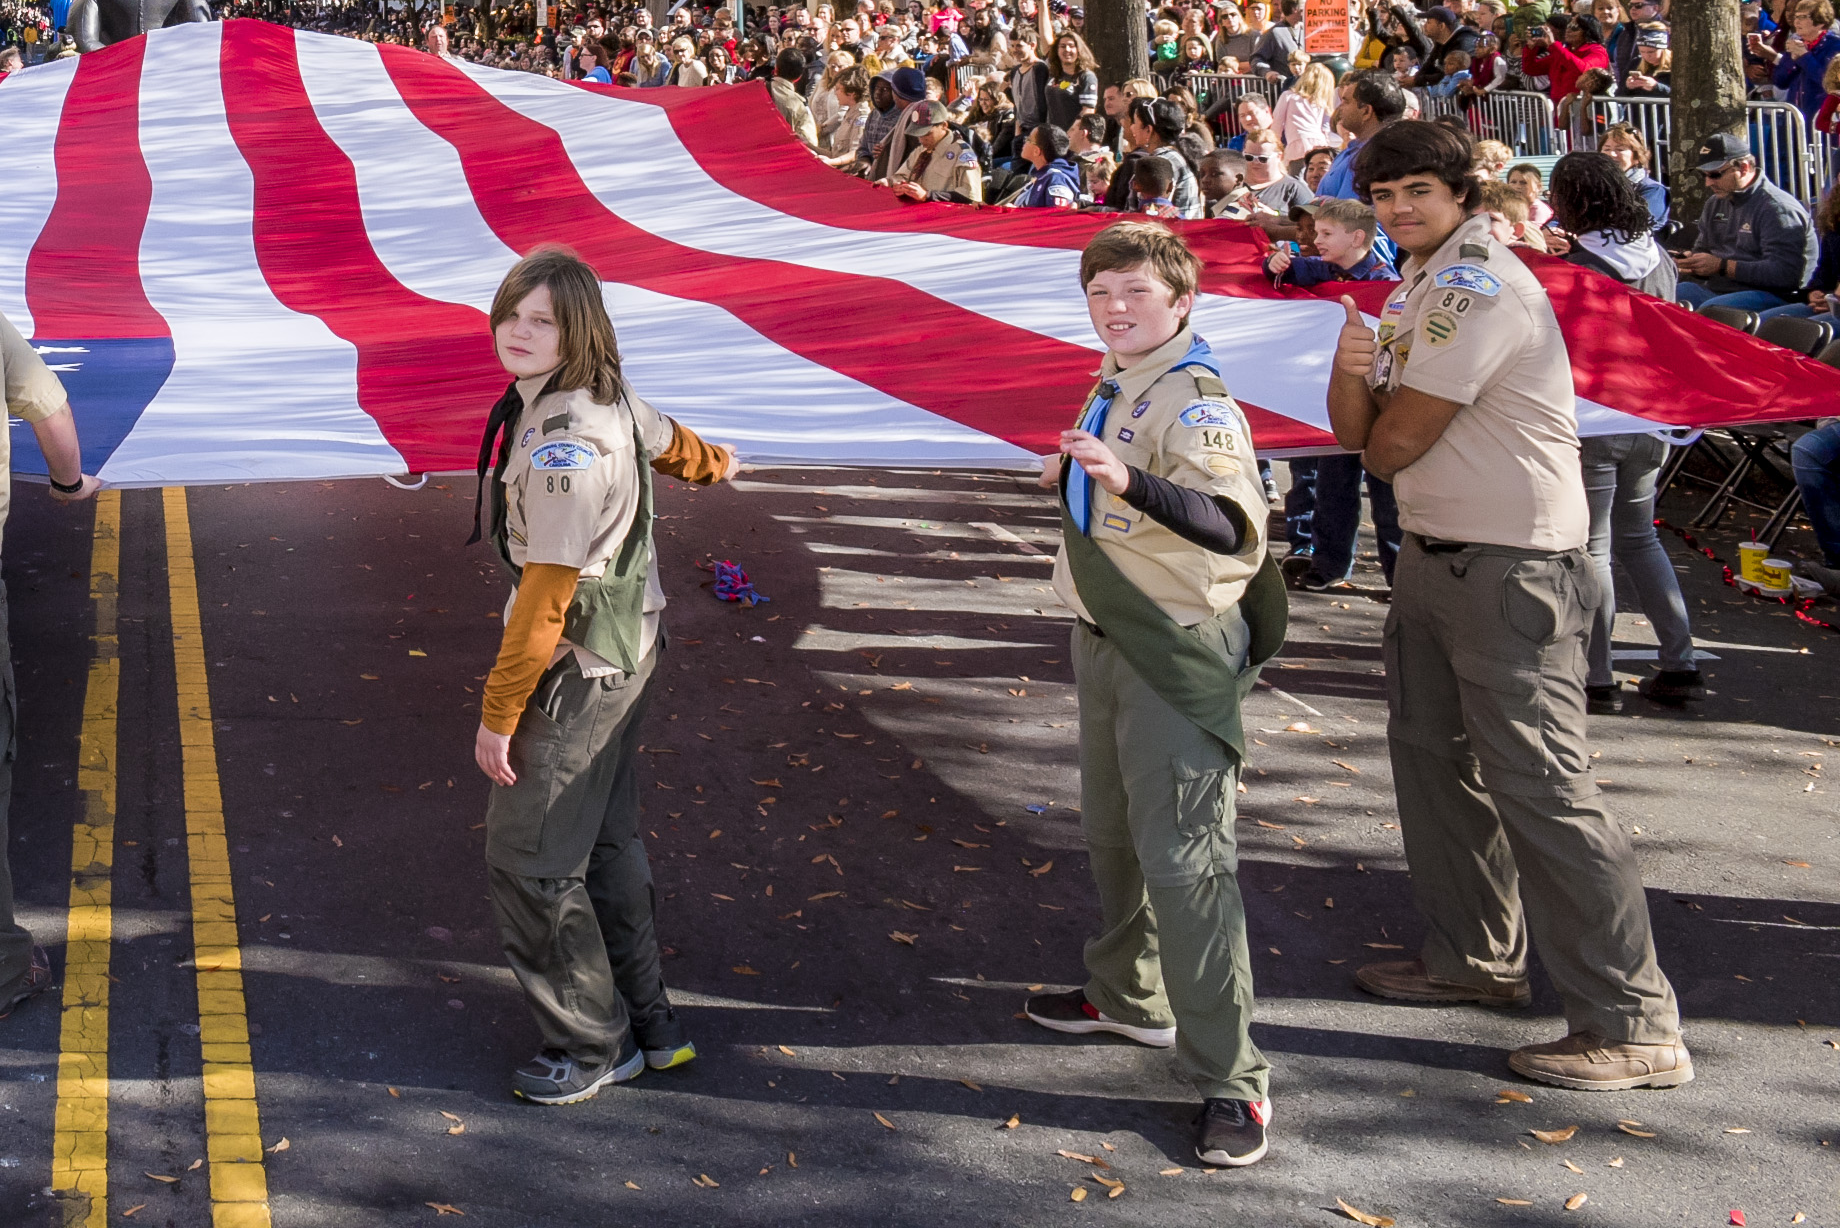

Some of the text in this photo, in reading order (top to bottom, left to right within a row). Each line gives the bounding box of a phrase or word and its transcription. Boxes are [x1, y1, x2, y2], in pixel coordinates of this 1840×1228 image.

[1307, 8, 1347, 17] PARKING
[1442, 292, 1470, 313] 80
[1202, 430, 1235, 451] 148
[546, 475, 570, 493] 80
